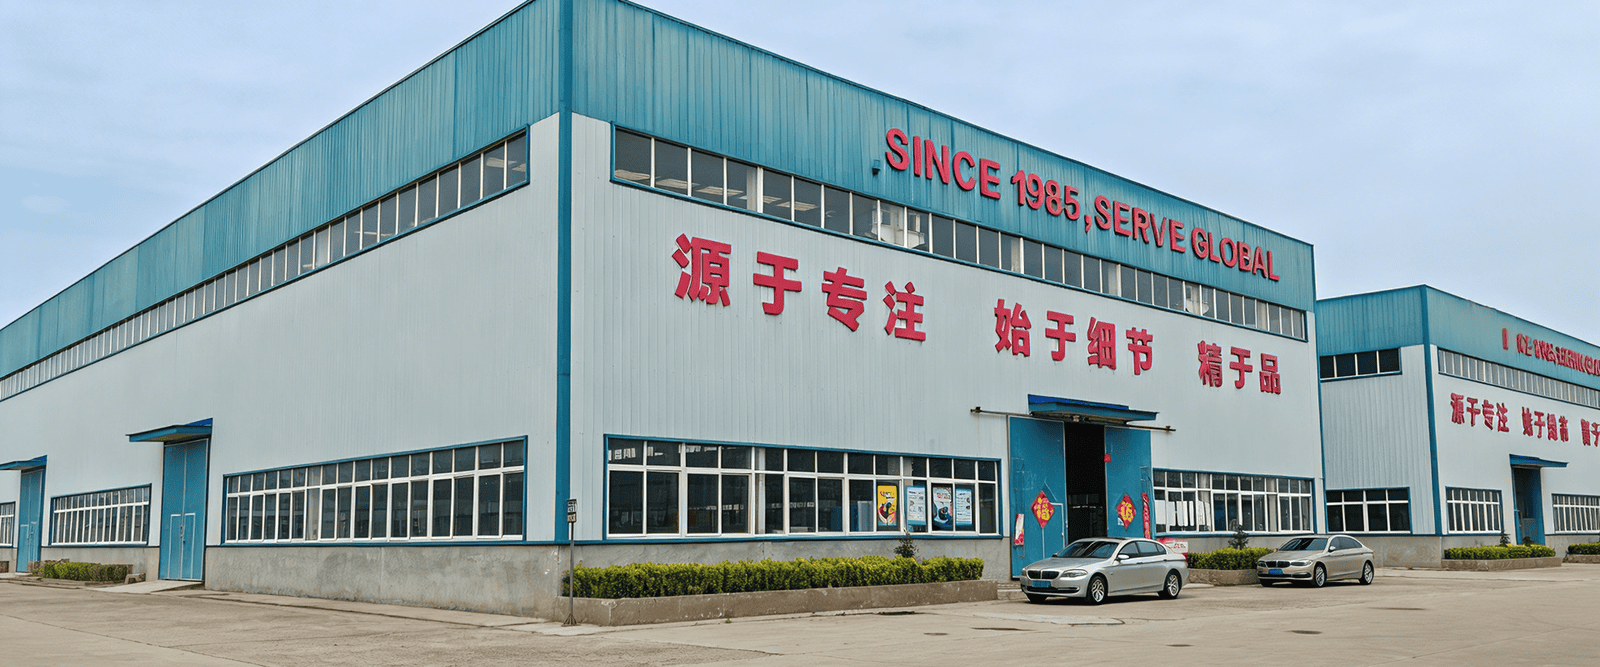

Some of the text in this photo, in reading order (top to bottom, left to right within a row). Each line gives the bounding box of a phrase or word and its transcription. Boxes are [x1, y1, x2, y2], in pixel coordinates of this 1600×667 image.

[885, 128, 1001, 200] SINCE
[1190, 227, 1281, 282] GLOBAL
[671, 233, 926, 342] 源于专注
[994, 298, 1154, 376] 始于细节
